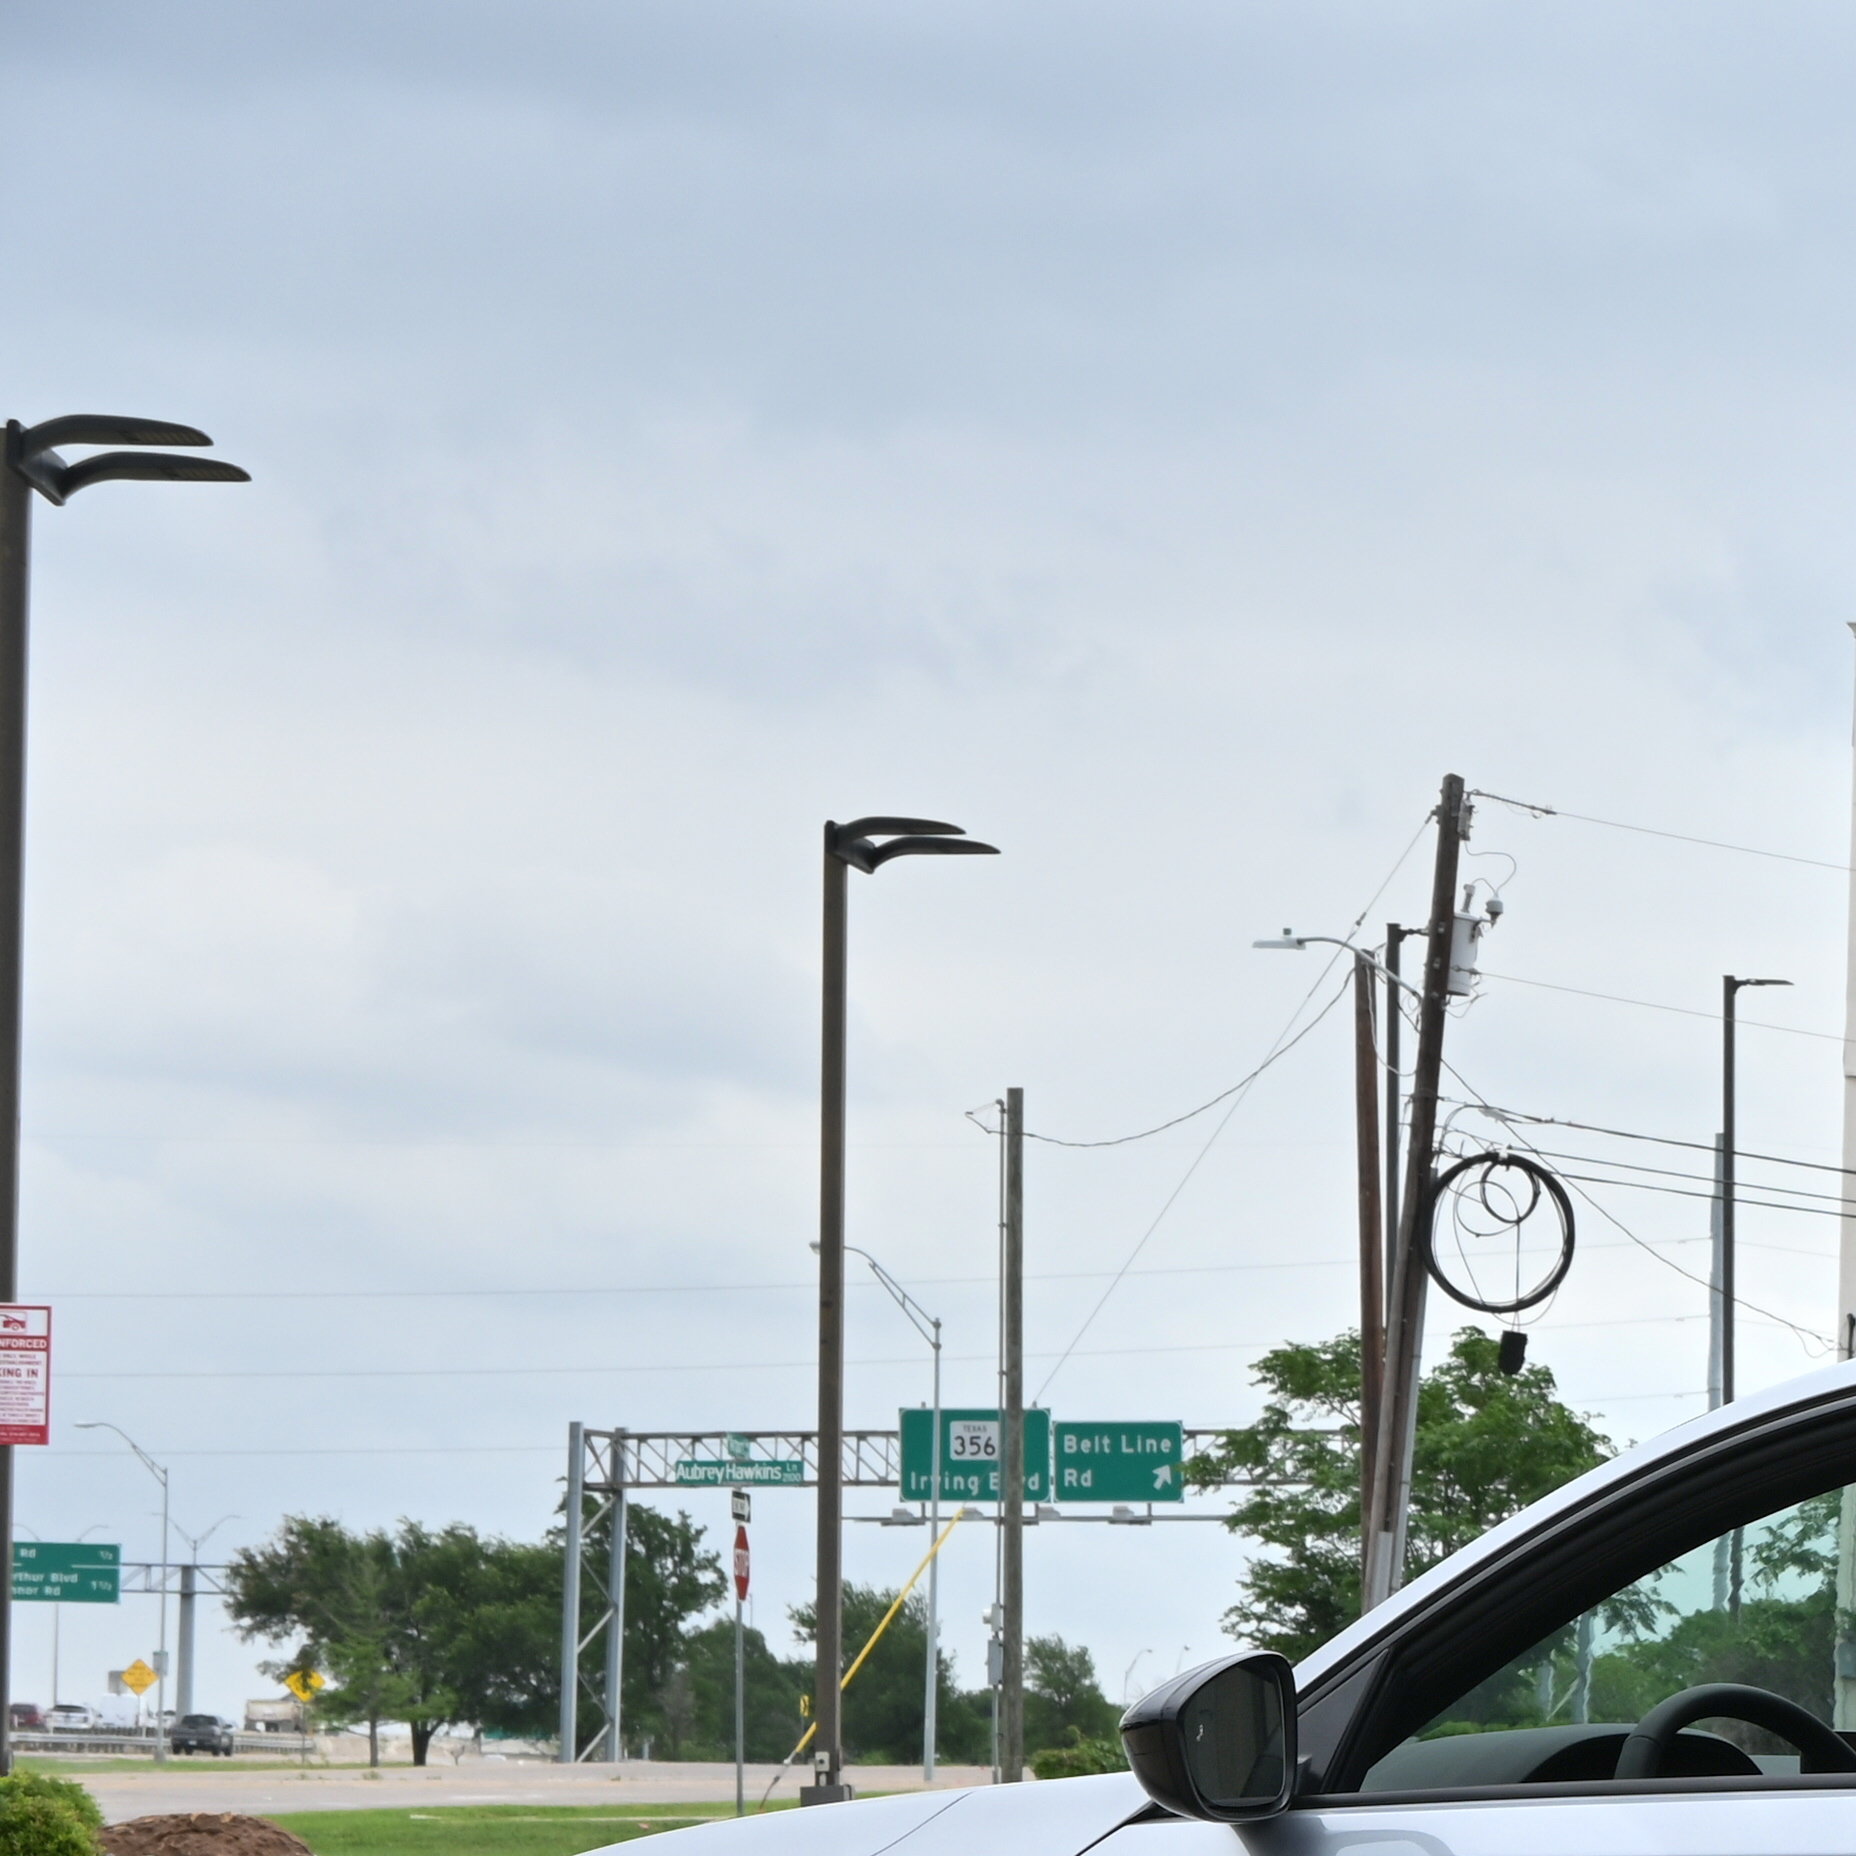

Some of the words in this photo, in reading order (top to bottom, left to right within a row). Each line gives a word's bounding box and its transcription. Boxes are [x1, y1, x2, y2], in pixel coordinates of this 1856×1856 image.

[963, 1425, 987, 1433] TEXAS
[954, 1435, 996, 1456] 356
[1063, 1434, 1110, 1453] Belt
[1121, 1434, 1172, 1453] Line
[676, 1462, 724, 1484] Aubrey
[725, 1462, 782, 1481] Hawkins
[786, 1462, 798, 1472] Ln
[1063, 1468, 1092, 1487] Rd
